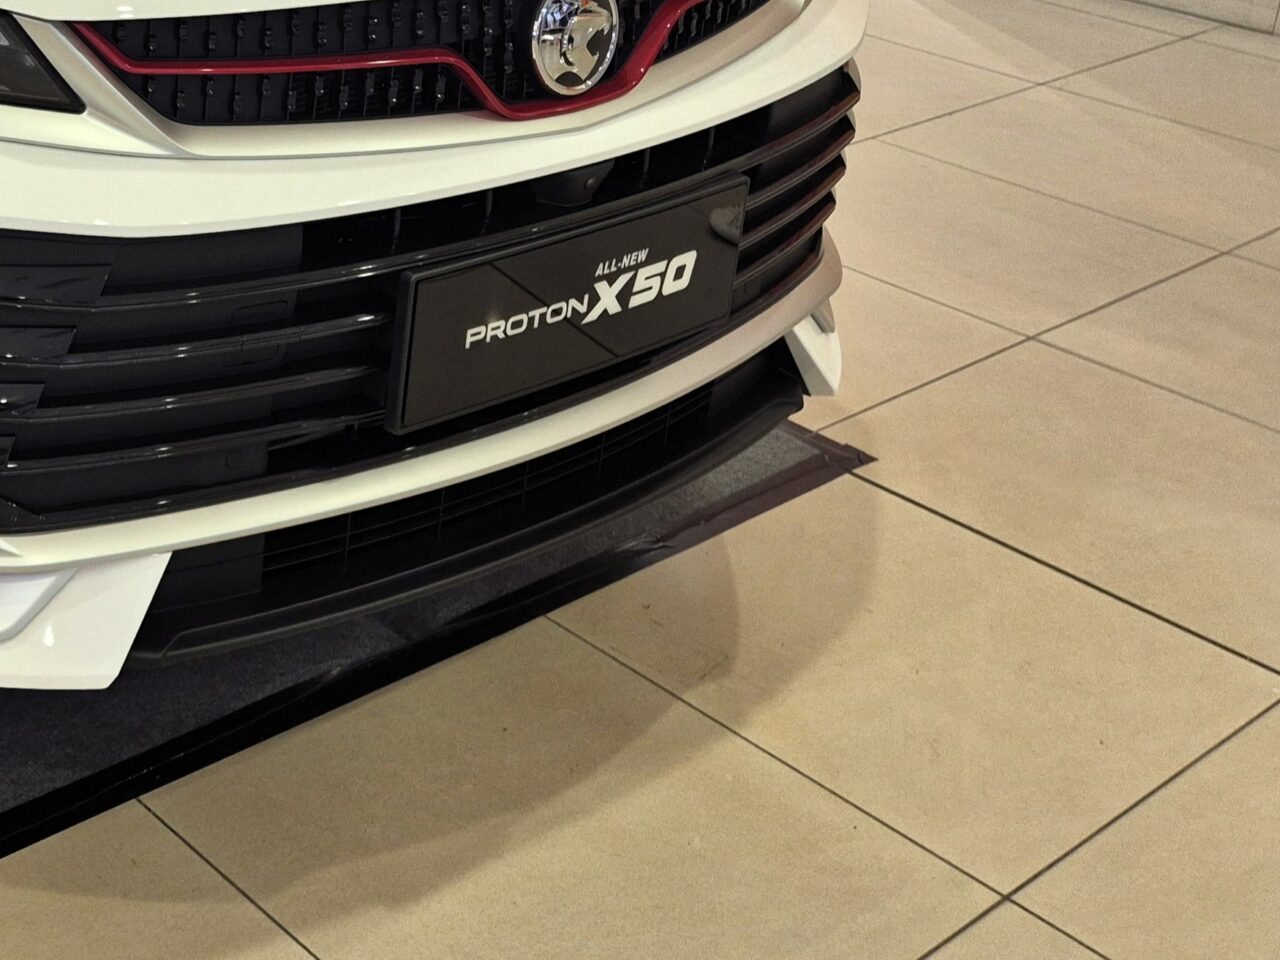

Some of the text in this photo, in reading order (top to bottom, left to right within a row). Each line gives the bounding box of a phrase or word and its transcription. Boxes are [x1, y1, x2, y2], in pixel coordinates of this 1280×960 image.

[594, 247, 650, 278] ALL-NEW
[464, 249, 698, 350] PROTON X50
